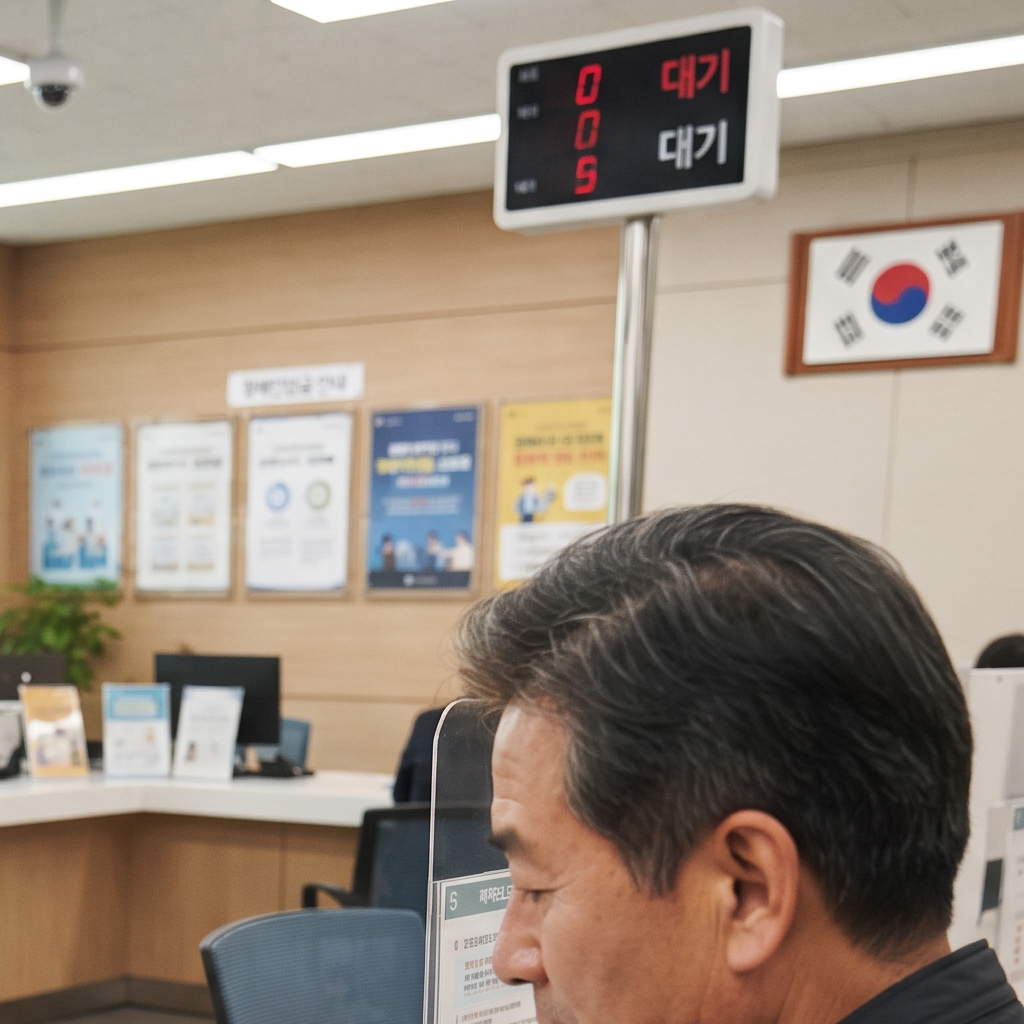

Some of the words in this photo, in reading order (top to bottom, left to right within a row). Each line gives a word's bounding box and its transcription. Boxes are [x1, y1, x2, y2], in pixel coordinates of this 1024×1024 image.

[575, 63, 603, 106] 0
[660, 47, 731, 100] 대기
[574, 109, 601, 151] 0
[658, 118, 728, 170] 대기
